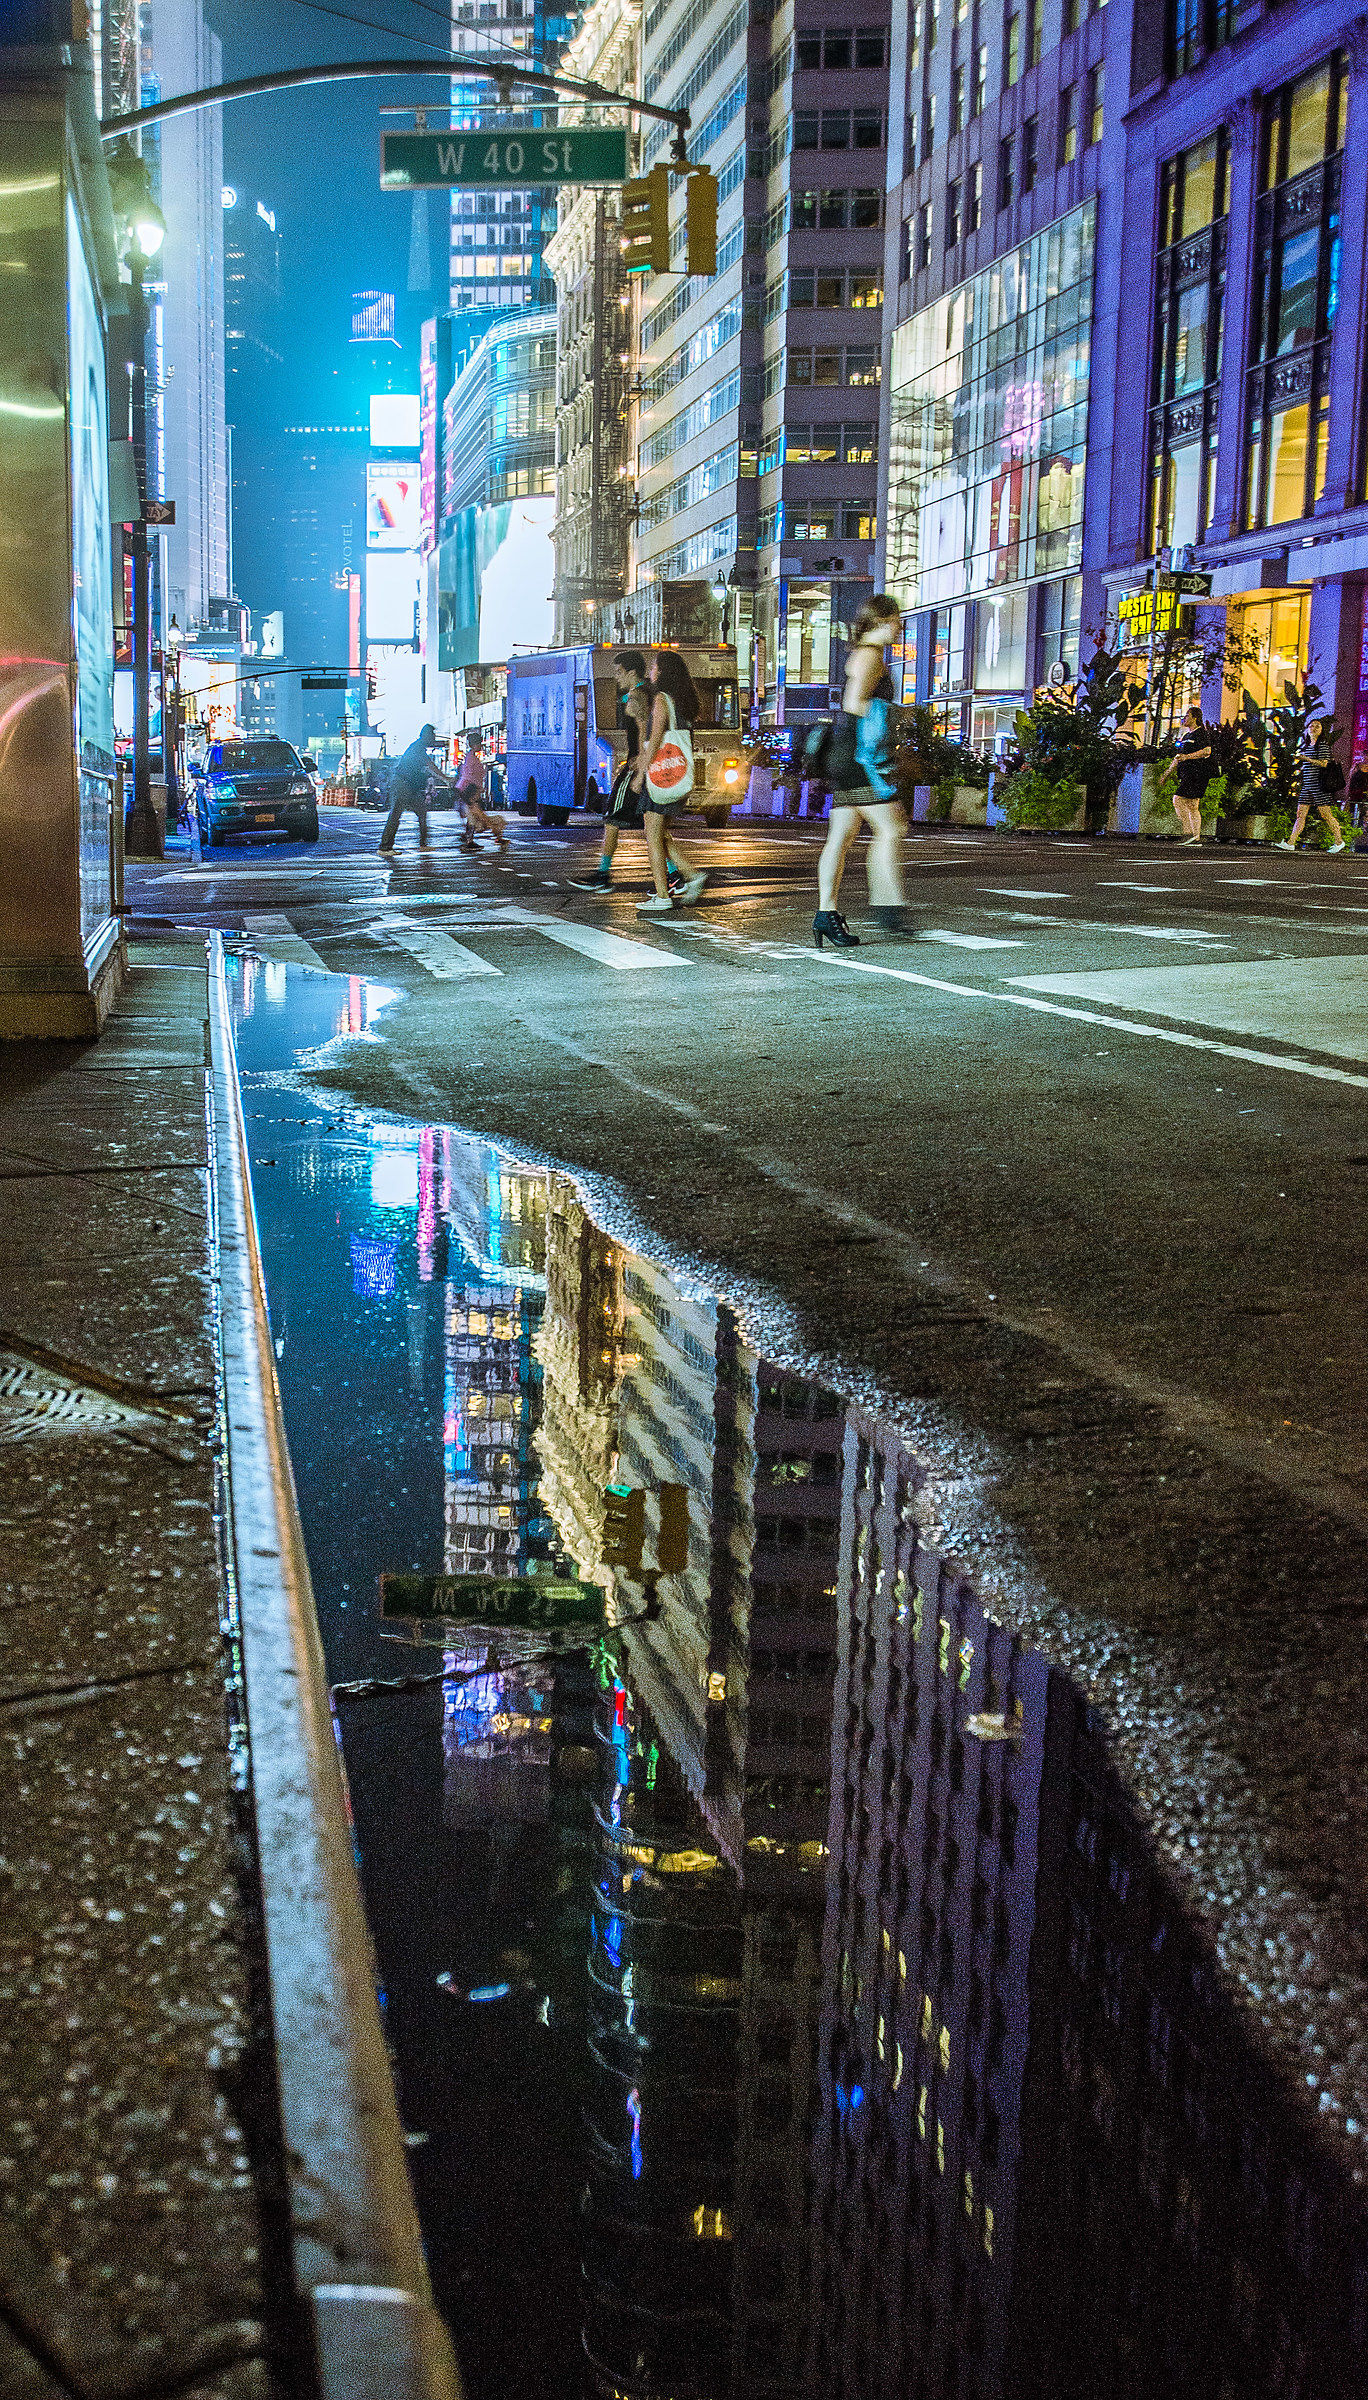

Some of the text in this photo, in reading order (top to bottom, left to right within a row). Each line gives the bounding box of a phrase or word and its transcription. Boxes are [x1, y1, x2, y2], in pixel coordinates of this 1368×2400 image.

[437, 140, 573, 175] W 40 St
